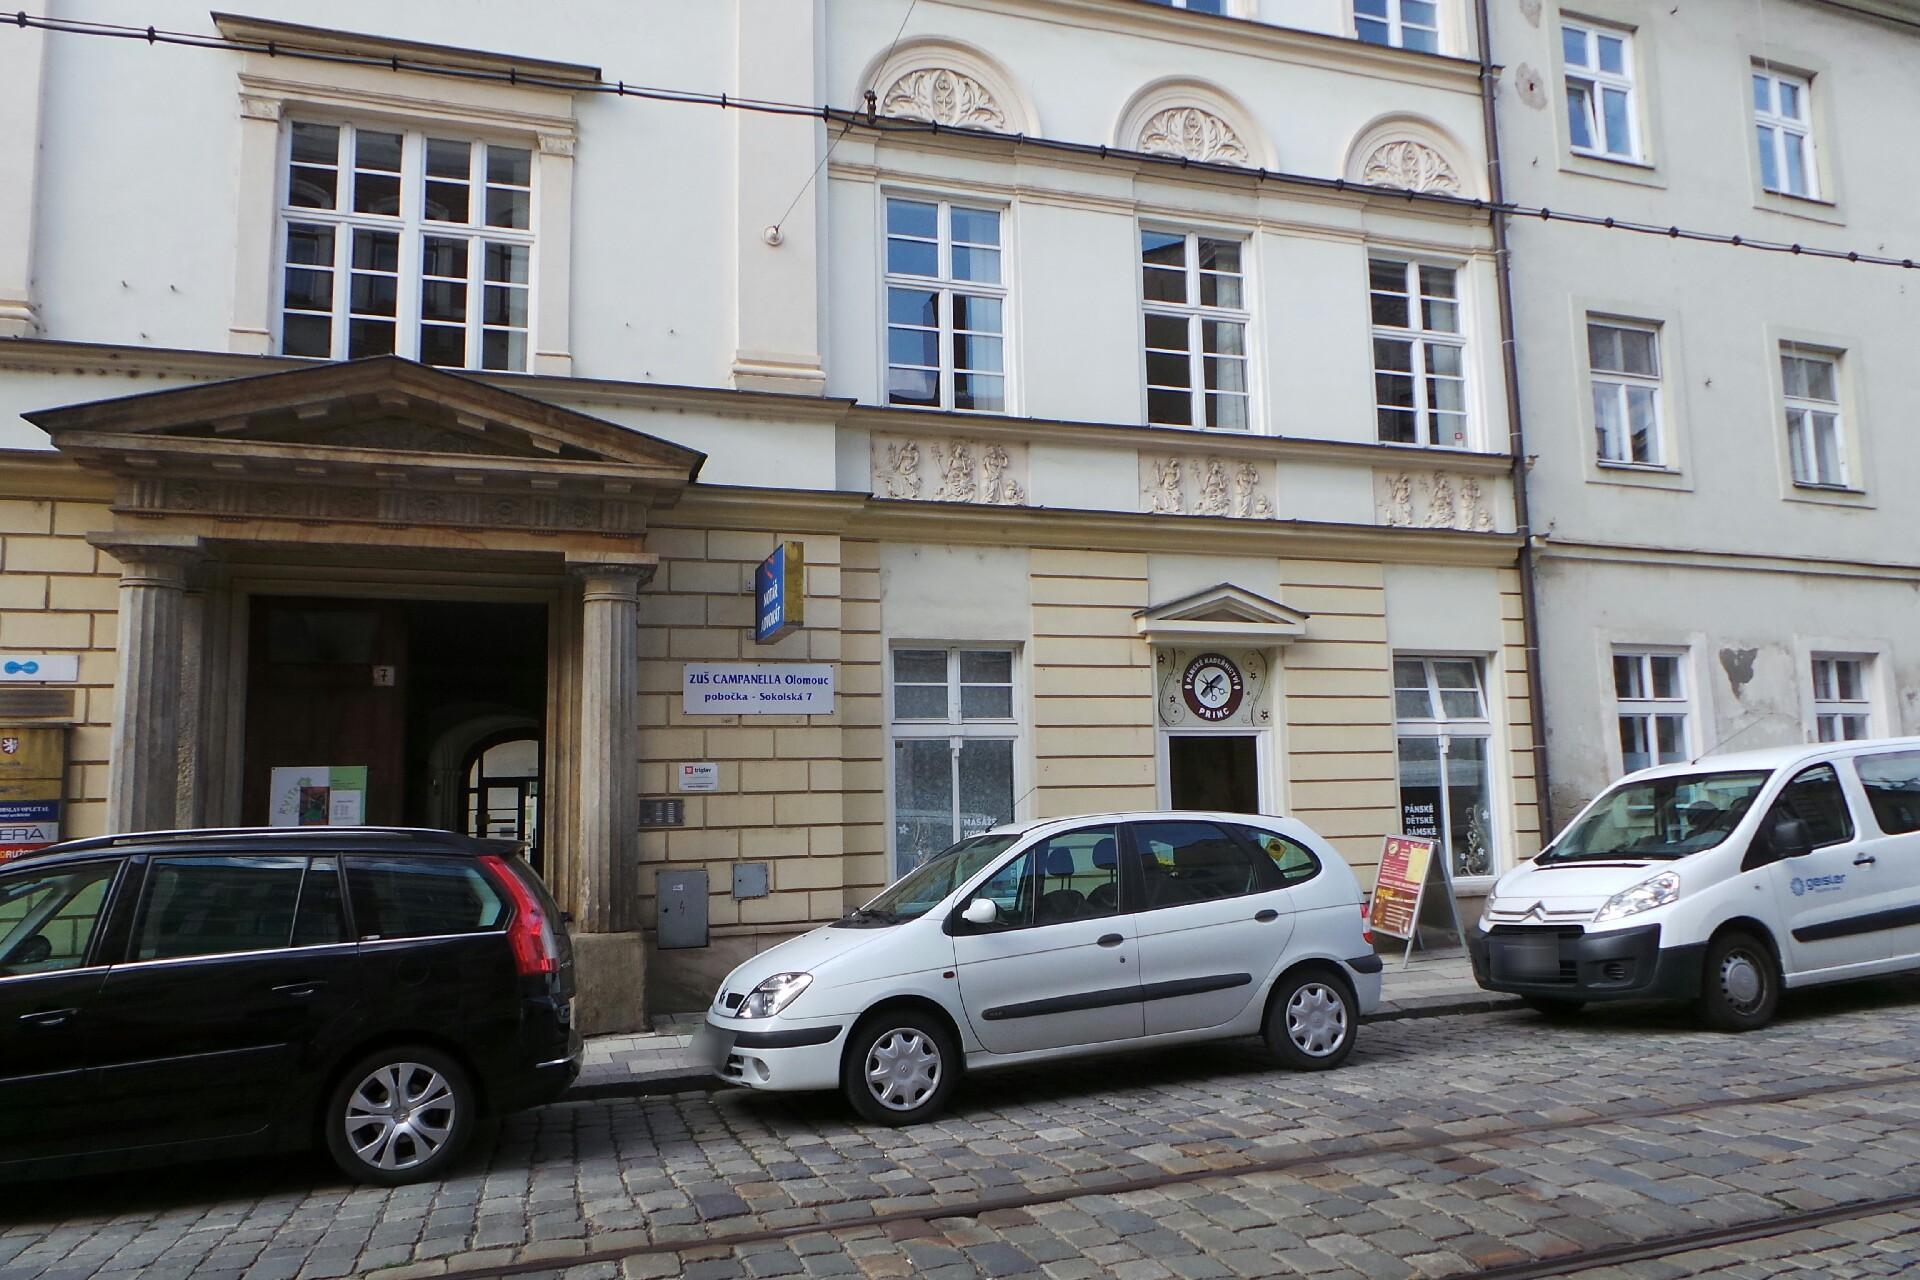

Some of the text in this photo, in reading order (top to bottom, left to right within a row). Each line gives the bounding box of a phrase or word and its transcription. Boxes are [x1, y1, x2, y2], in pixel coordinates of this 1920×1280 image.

[763, 579, 778, 608] NOTÁŘ
[761, 603, 780, 632] ADVOKÁT
[380, 669, 388, 682] 7
[1186, 659, 1204, 683] PÁNSKÉ
[689, 671, 829, 685] ZUŠ CAMPANELLA Olomouc
[704, 692, 748, 703] pobočka
[759, 692, 802, 701] Sokolská
[806, 692, 813, 701] 7
[1199, 708, 1229, 719] PRINC
[1404, 803, 1434, 813] PÁNSKÉ
[1405, 815, 1434, 824] DĚTSKÉ
[1407, 826, 1437, 836] DÁMSKÉ
